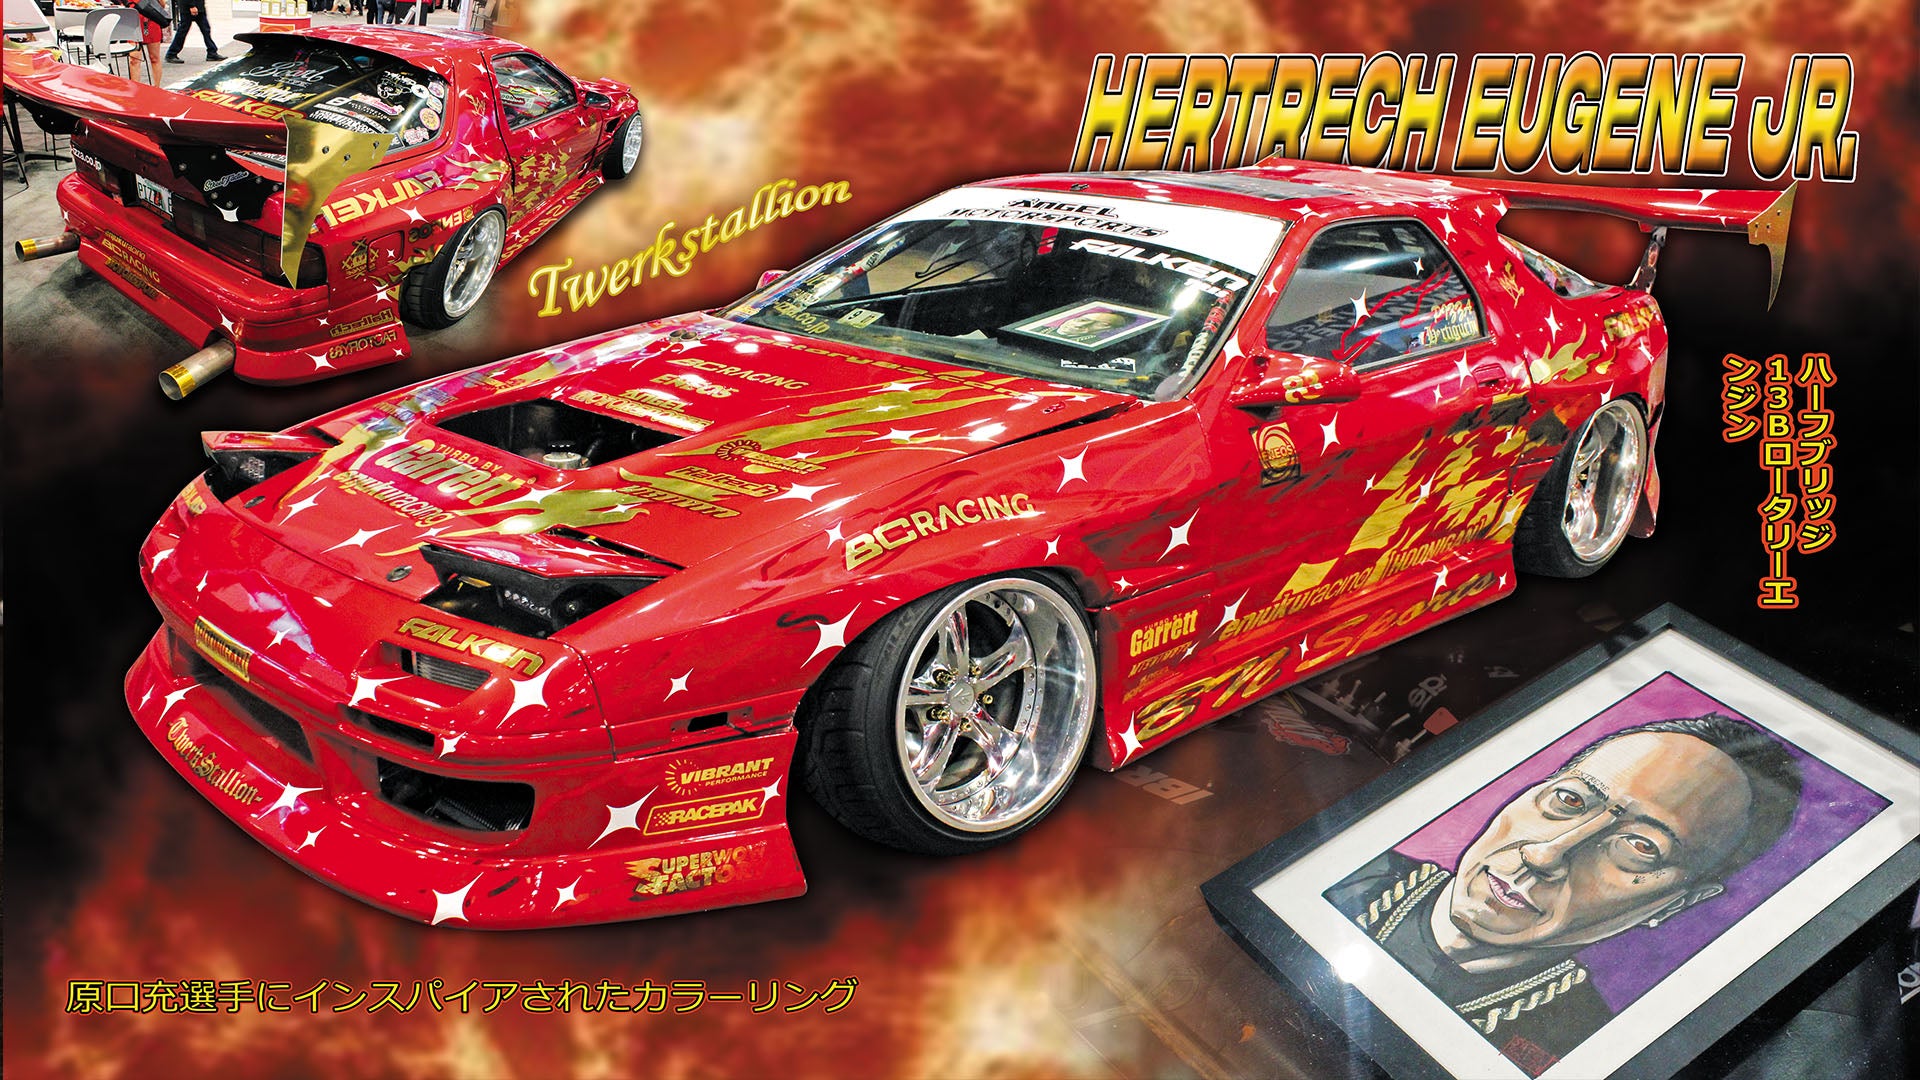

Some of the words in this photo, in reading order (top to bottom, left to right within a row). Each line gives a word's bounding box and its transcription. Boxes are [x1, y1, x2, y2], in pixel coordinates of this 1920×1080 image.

[945, 208, 1168, 238] MOTORSPORTS
[1069, 238, 1249, 292] FALKEN
[435, 443, 480, 464] TURBO
[481, 459, 503, 473] BY
[1261, 445, 1293, 461] ENEOS
[398, 617, 544, 676] FALKEN
[1130, 609, 1198, 657] Garrett
[680, 757, 774, 785] VIBRANT
[704, 770, 768, 787] PERFORMANCE
[1570, 769, 1610, 793] EXTREME
[669, 797, 758, 825] RACEPAK
